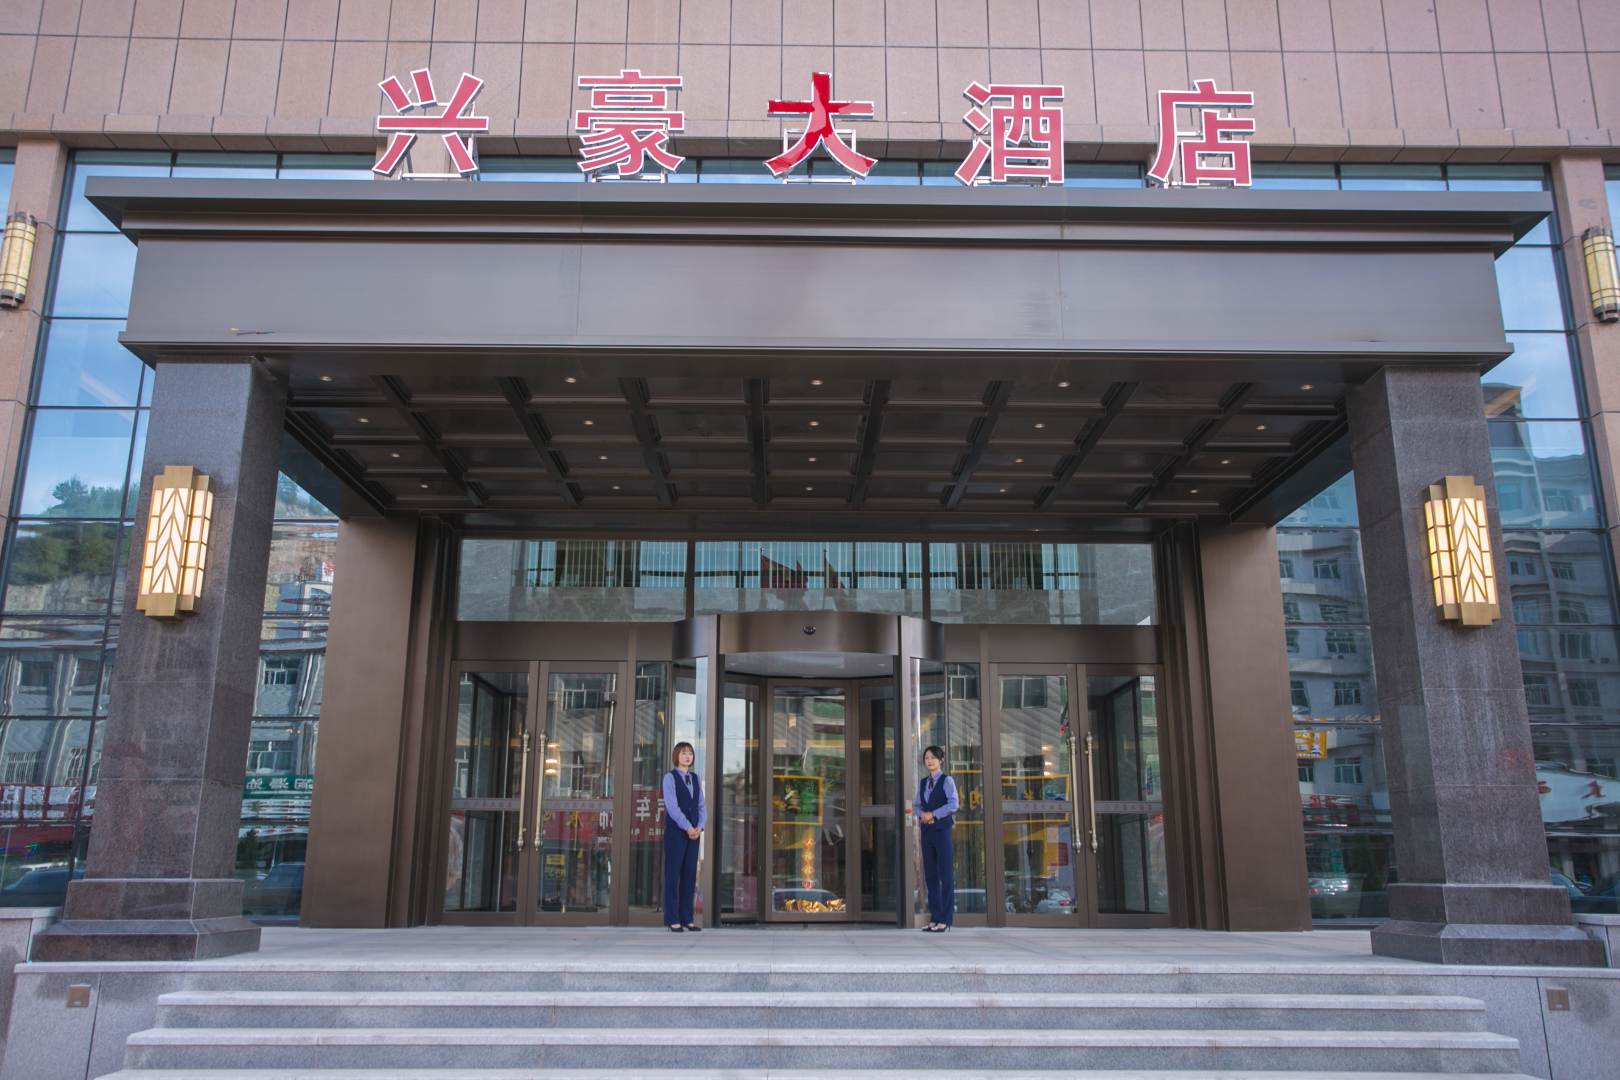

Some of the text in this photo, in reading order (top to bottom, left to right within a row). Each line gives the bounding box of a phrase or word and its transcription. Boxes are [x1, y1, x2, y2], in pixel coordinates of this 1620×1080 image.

[371, 68, 1257, 187] 兴豪大酒店
